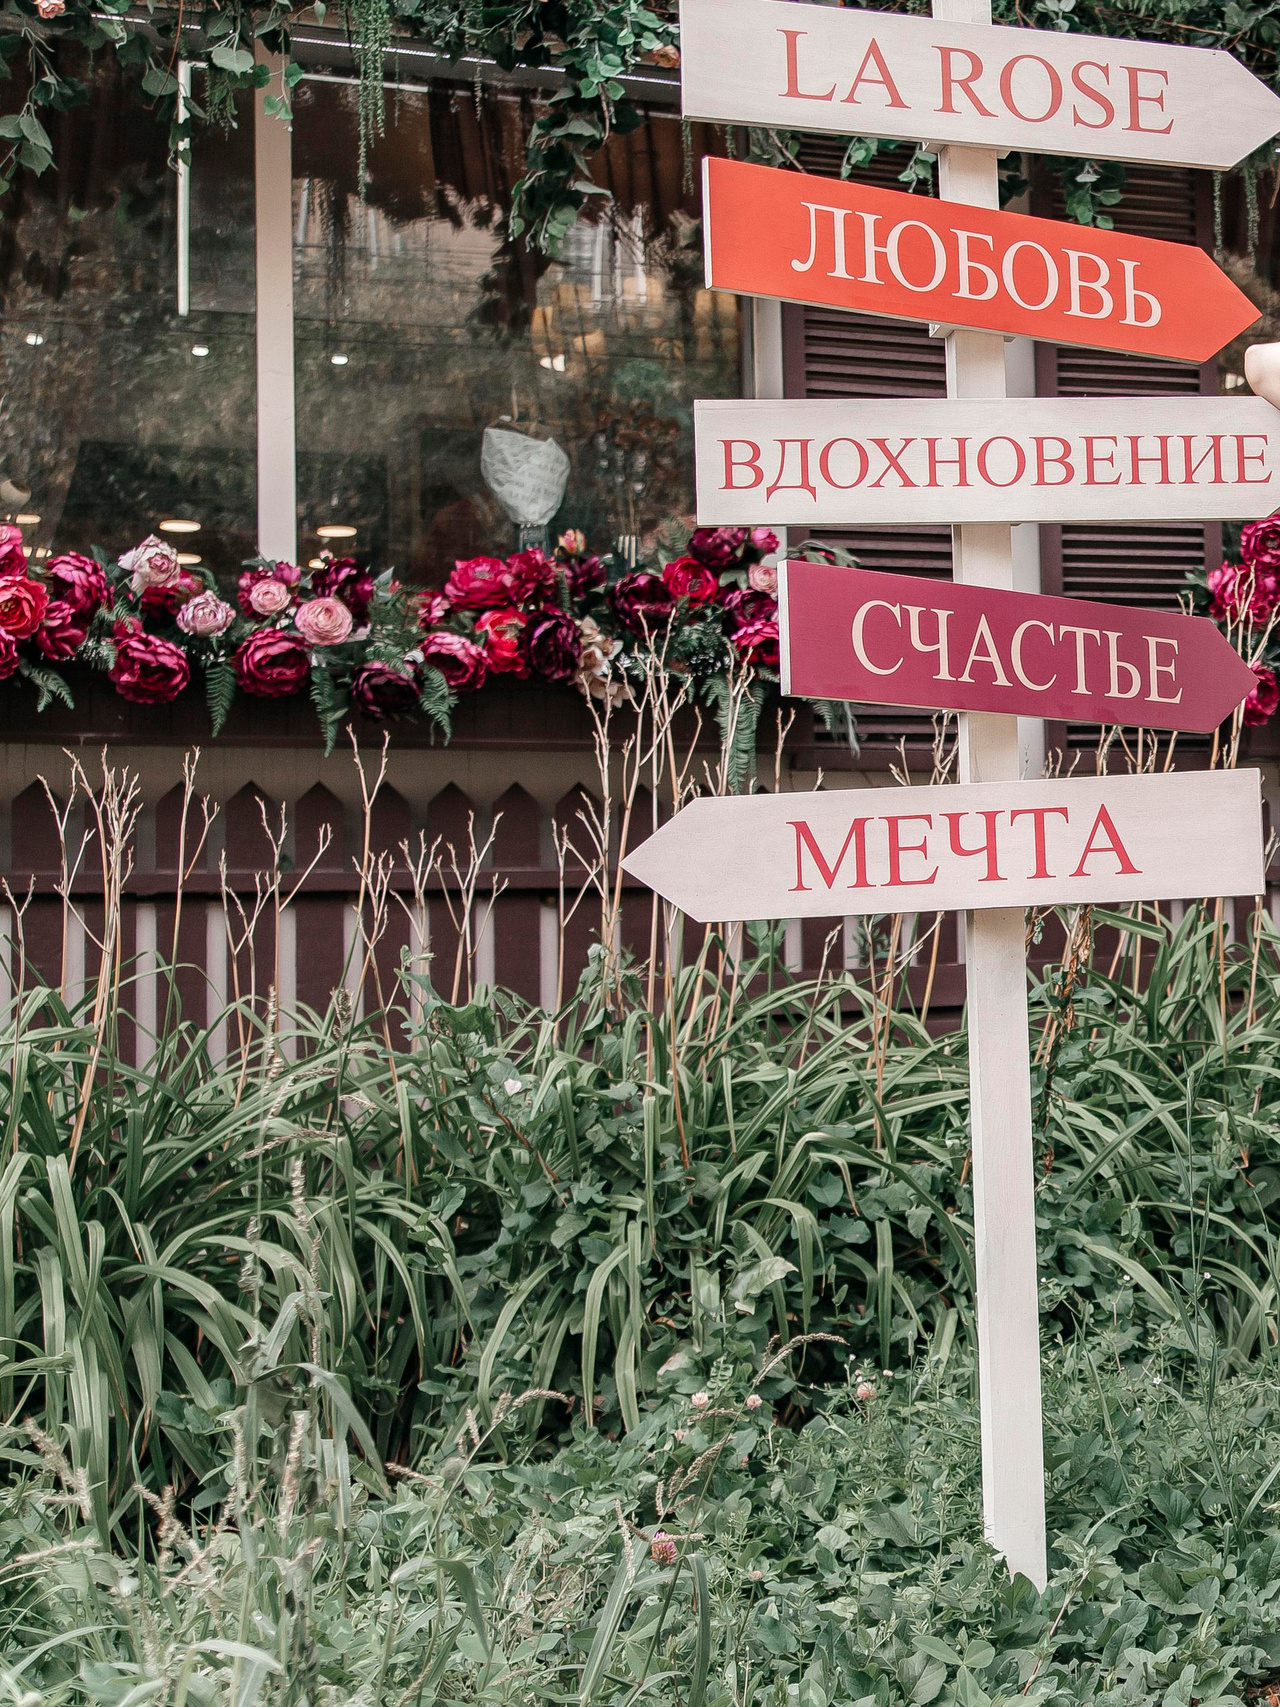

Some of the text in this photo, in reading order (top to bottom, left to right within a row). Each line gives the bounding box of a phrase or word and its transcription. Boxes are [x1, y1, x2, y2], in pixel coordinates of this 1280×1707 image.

[777, 29, 1174, 135] LA ROSE
[791, 202, 1162, 328] ЛЮБОВЬ
[717, 434, 1273, 502] ВДОХНОВЕНИЕ
[851, 599, 1184, 705] СЧАСТЬЕ
[786, 803, 1143, 893] МЕЧТА
